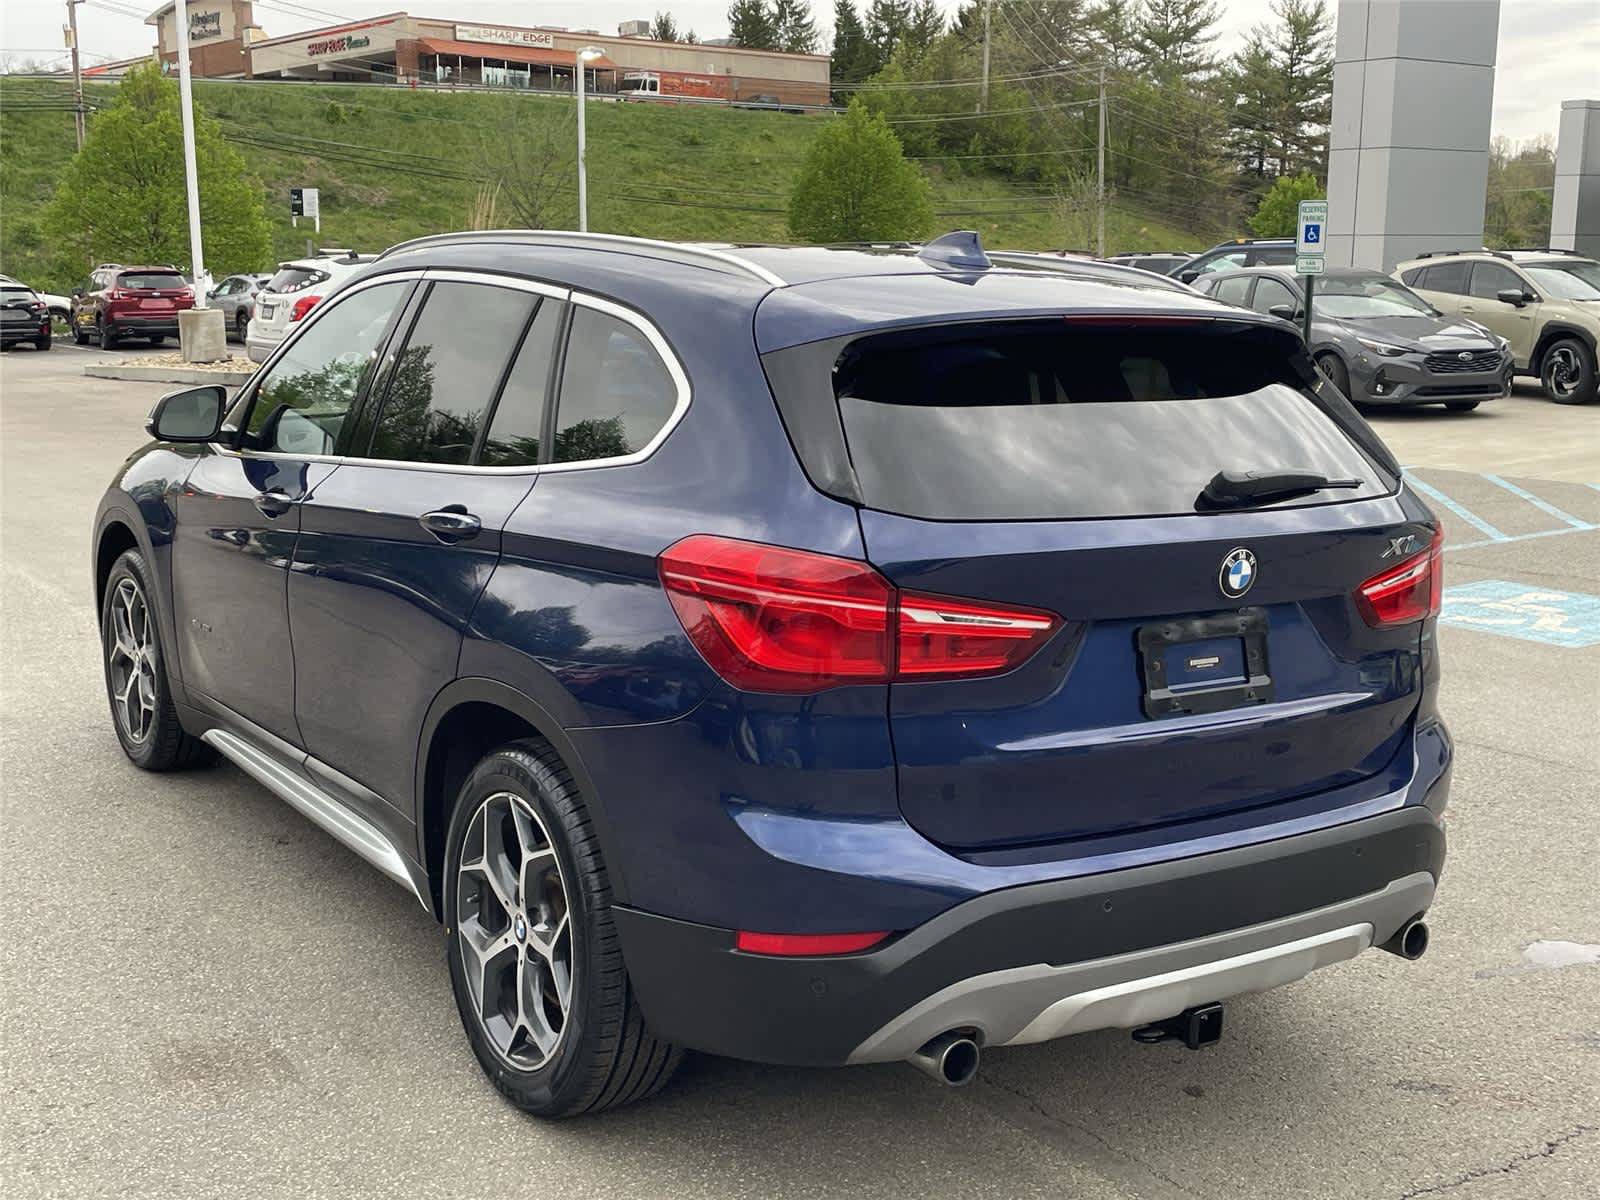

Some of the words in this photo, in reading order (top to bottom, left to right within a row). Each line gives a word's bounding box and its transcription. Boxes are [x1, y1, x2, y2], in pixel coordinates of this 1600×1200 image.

[482, 29, 519, 40] SHARP
[523, 33, 551, 44] EDGE
[1381, 534, 1415, 558] X1
[1226, 551, 1256, 568] BMW
